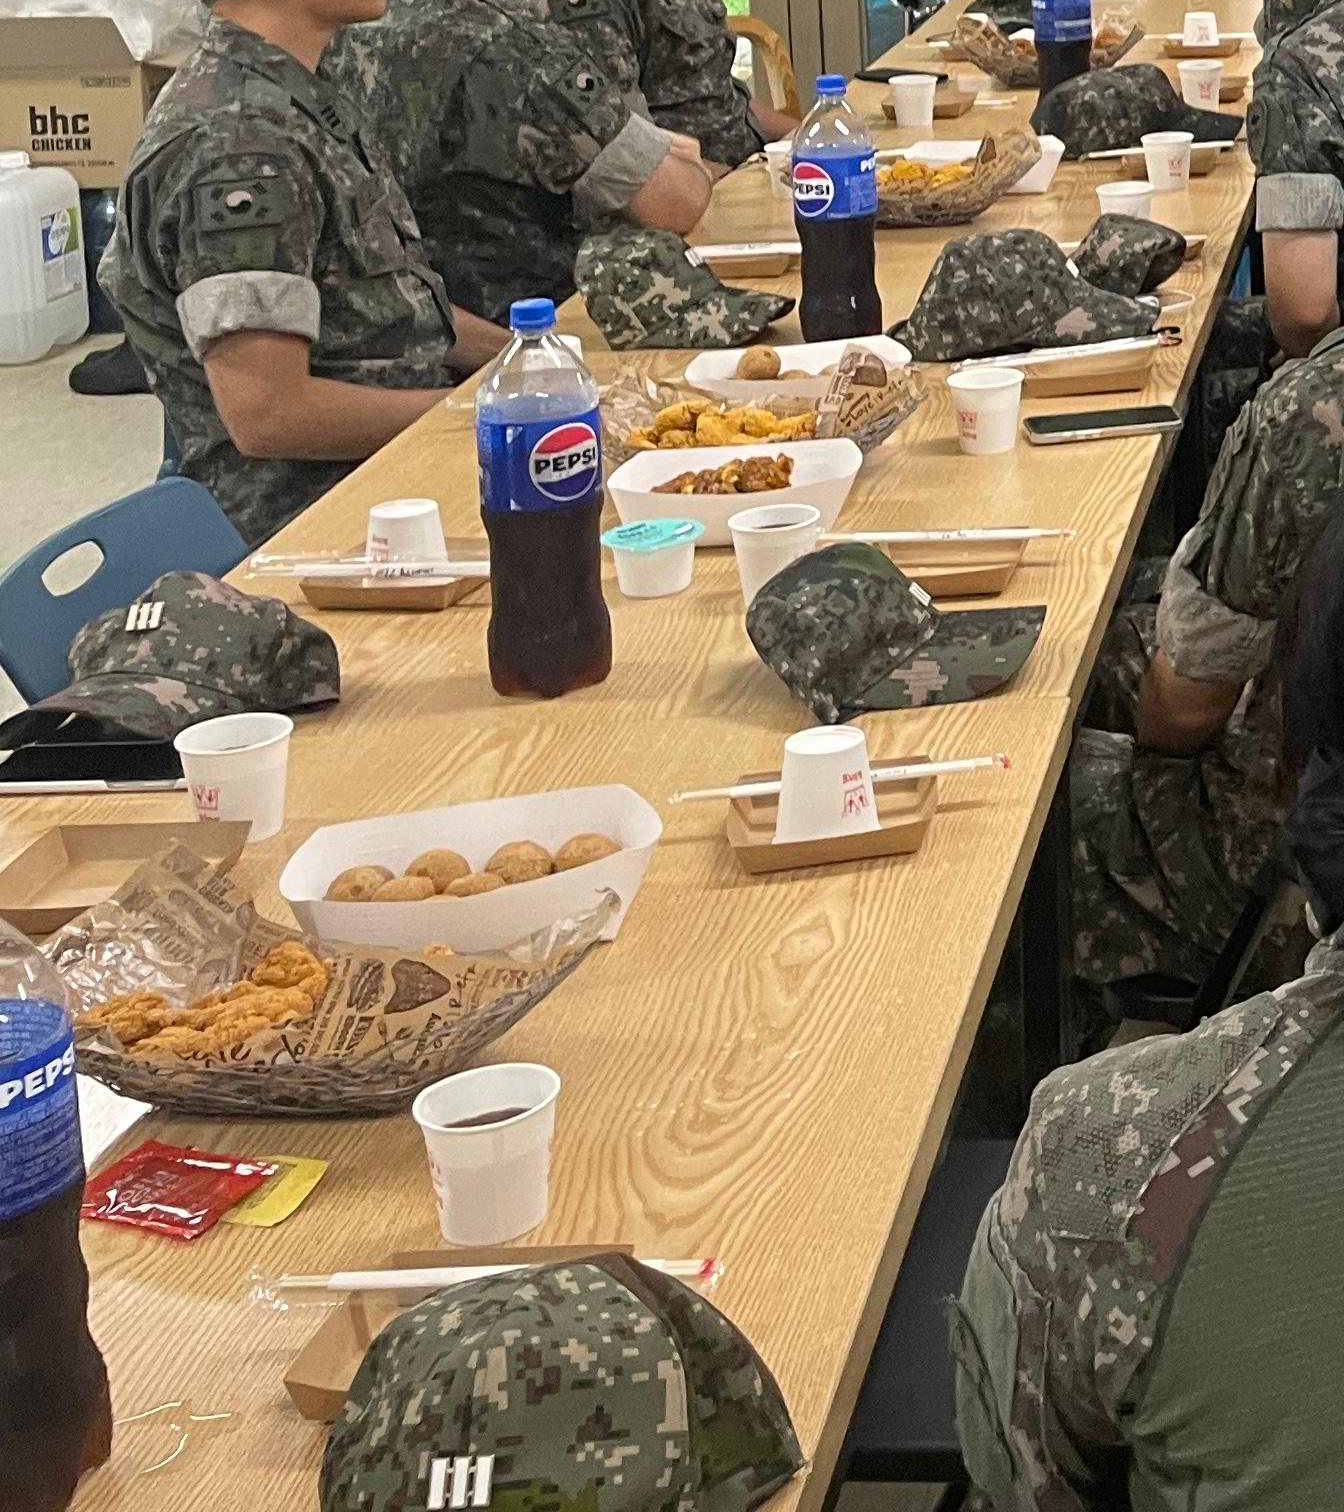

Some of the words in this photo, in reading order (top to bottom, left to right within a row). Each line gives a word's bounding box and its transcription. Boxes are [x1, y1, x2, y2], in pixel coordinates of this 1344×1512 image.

[28, 105, 91, 137] bhc
[31, 137, 92, 152] CHICKEN
[534, 446, 597, 475] PEPSI
